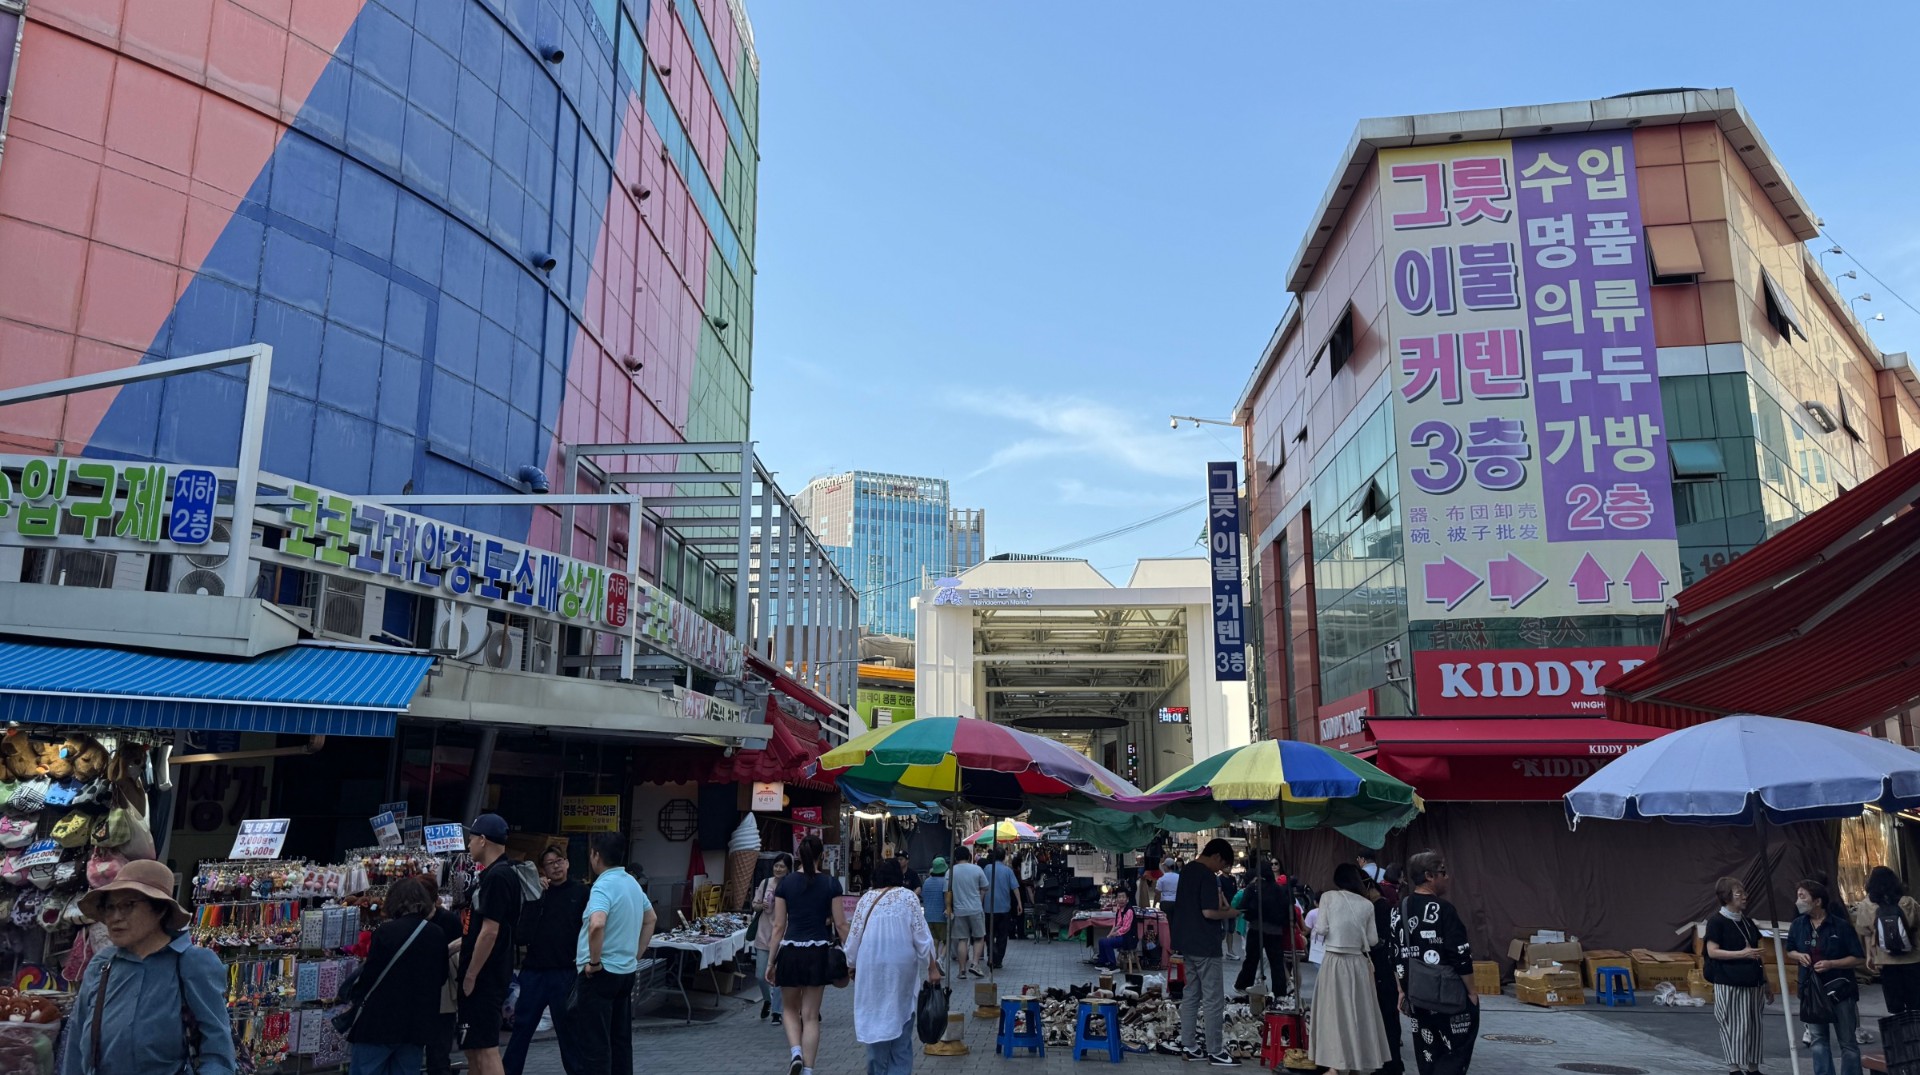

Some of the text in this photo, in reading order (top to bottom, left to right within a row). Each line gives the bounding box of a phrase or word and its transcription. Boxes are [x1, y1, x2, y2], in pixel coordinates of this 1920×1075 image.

[1391, 156, 1511, 230] 그릇
[1520, 146, 1628, 203] 수입
[1526, 211, 1637, 269] 명품
[1393, 242, 1521, 316] 이불
[1534, 279, 1646, 334] 의류
[1399, 328, 1530, 406] 커텐
[1537, 346, 1652, 404] 구두
[1408, 416, 1532, 495] 3층
[1545, 413, 1660, 473] 가방
[176, 474, 216, 505] 지하
[1565, 482, 1655, 531] 2층
[173, 507, 210, 541] 2층
[607, 602, 626, 624] 1층
[608, 577, 628, 600] 지하
[1216, 651, 1245, 673] 3층
[1439, 659, 1606, 698] KIDDY
[1589, 744, 1623, 754] KIDDY
